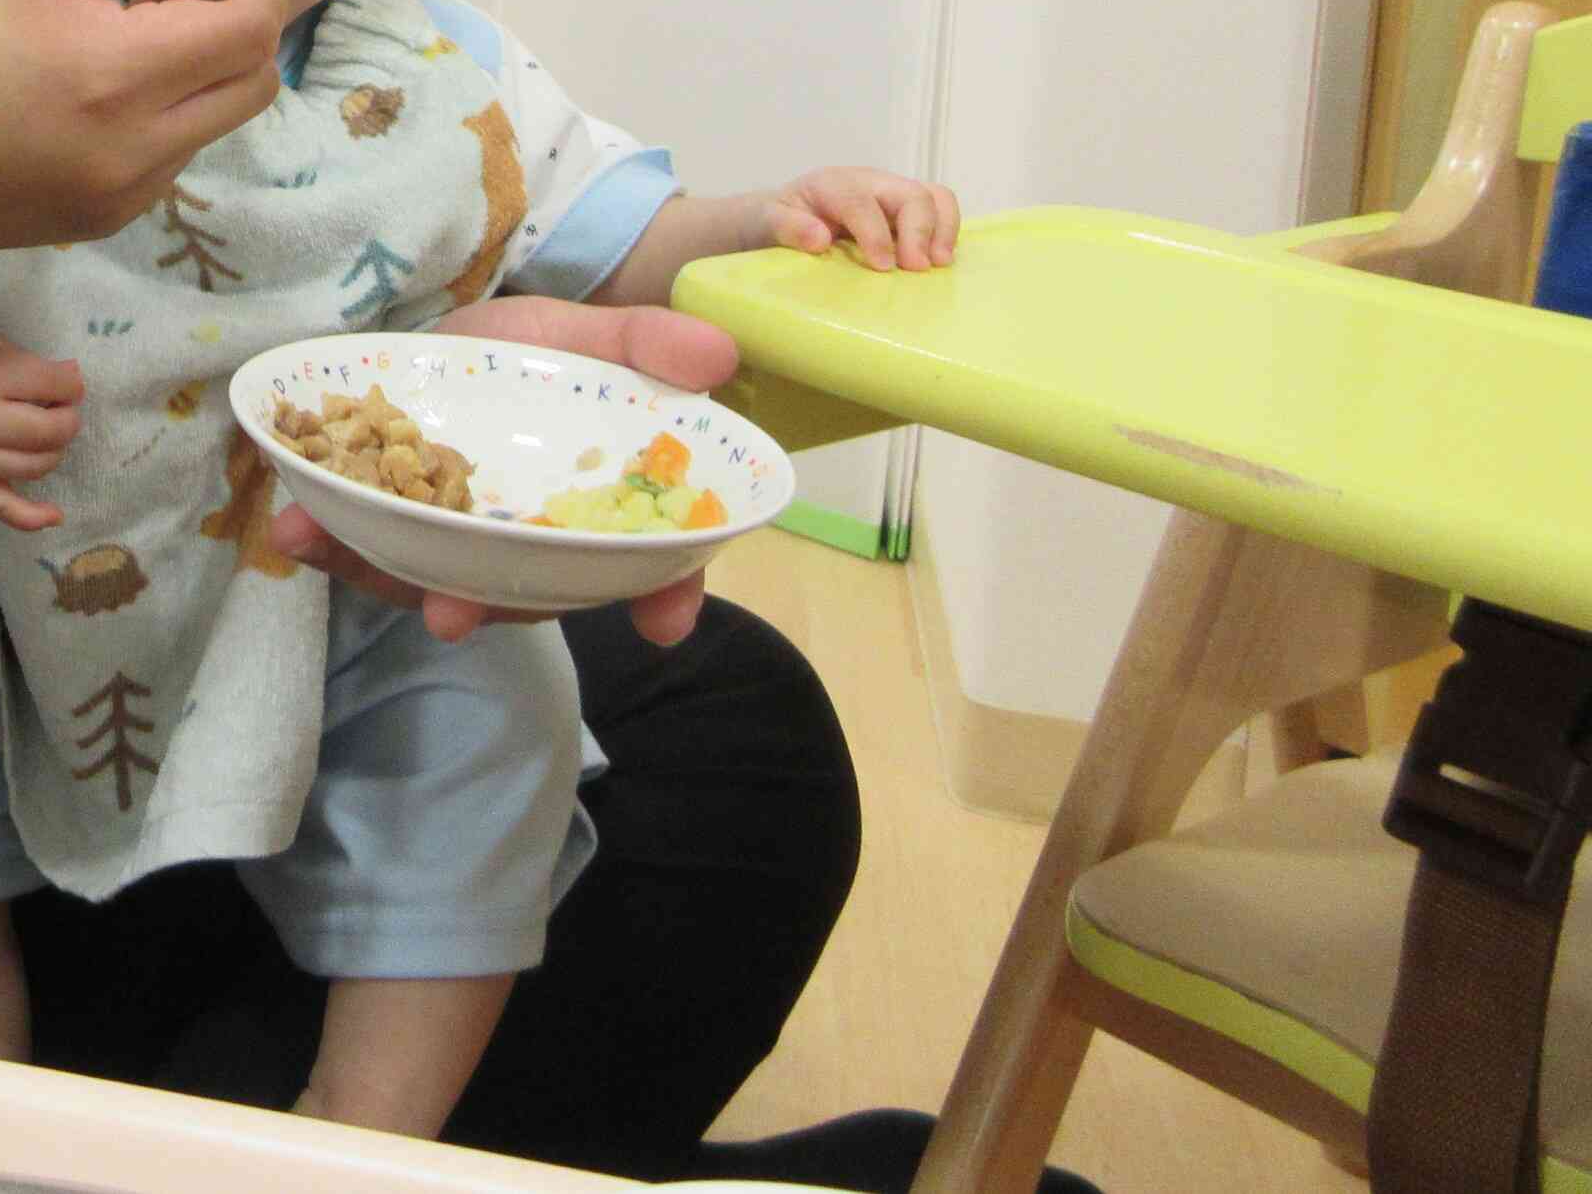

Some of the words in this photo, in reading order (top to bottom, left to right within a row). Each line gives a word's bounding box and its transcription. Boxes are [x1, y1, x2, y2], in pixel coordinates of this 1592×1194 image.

[303, 361, 314, 381] E
[339, 365, 351, 387] F
[485, 354, 498, 372] I
[598, 382, 612, 402] K
[728, 447, 747, 465] N
